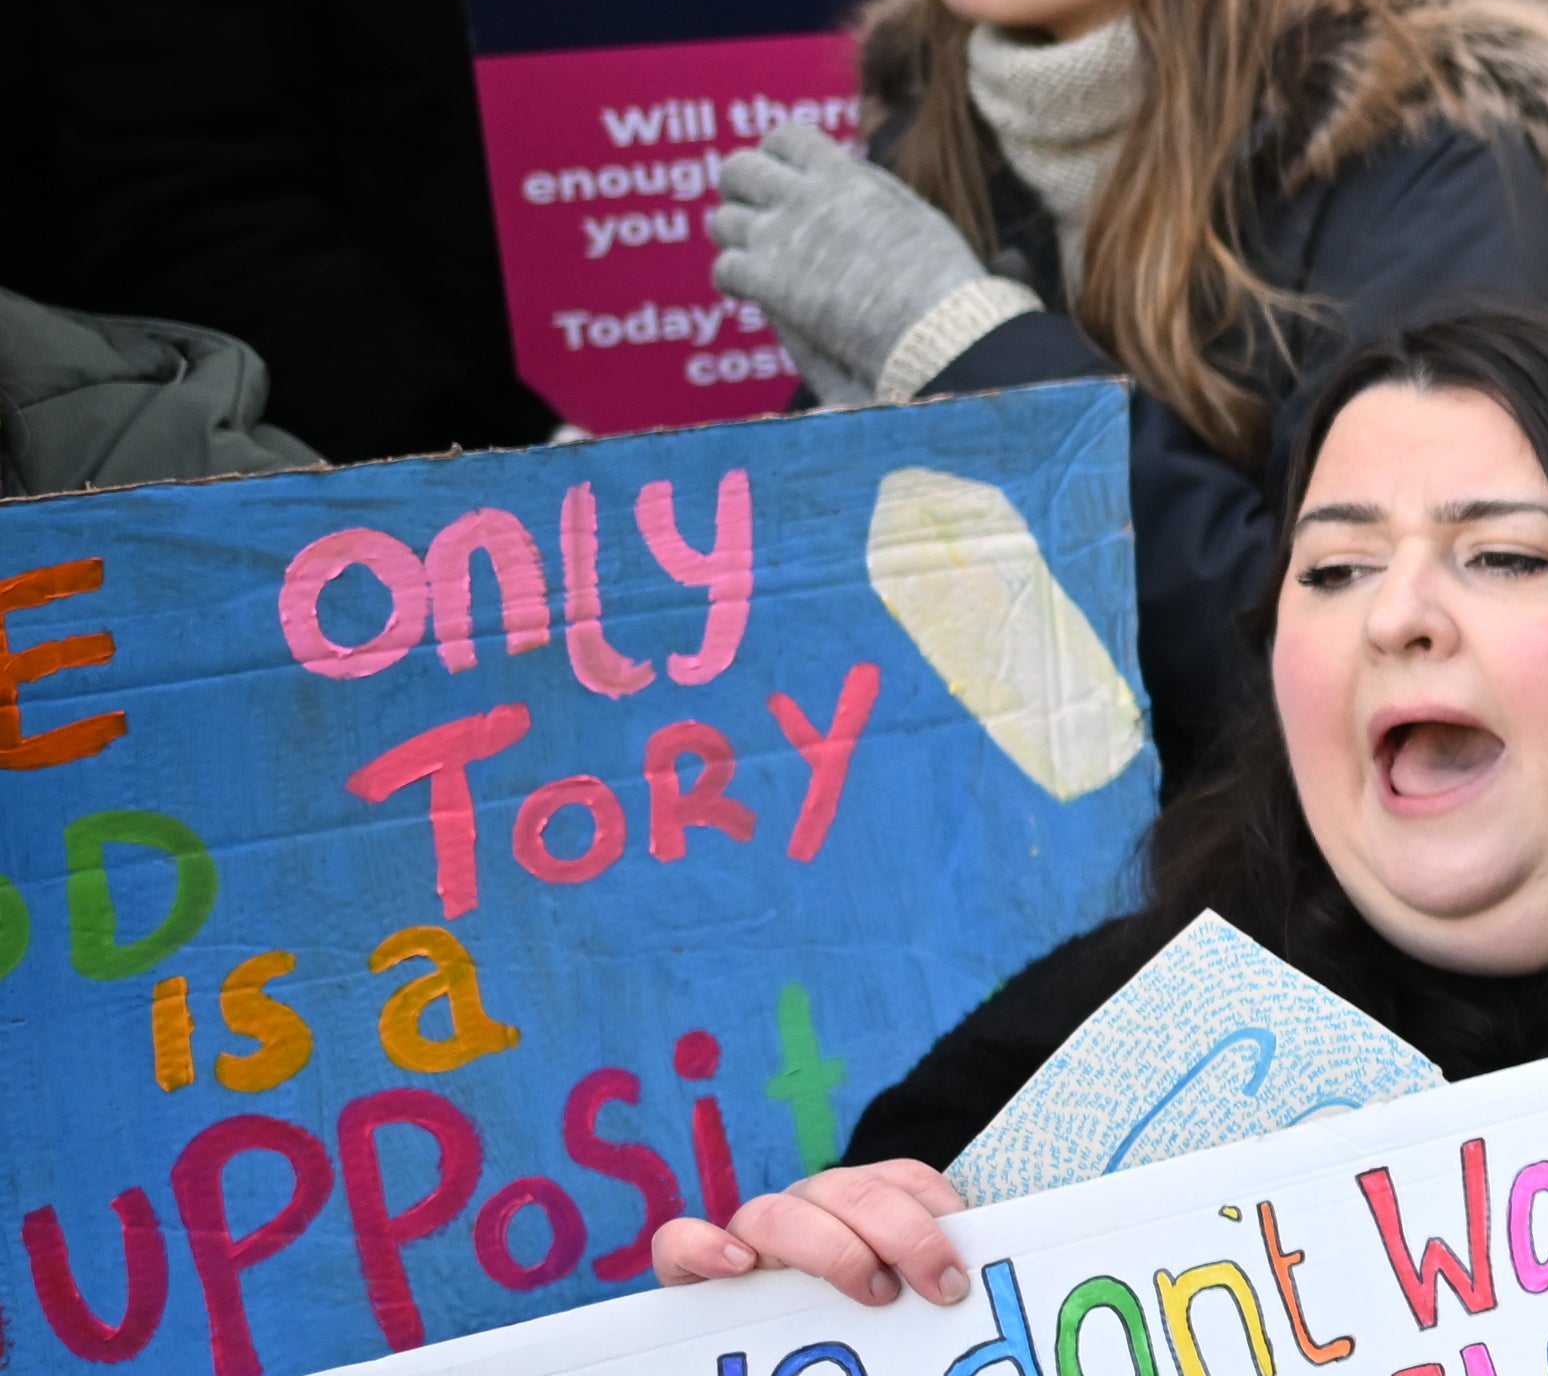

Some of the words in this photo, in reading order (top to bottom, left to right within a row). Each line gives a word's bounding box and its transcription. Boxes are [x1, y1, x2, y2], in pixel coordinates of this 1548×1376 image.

[601, 97, 718, 149] Will
[581, 208, 690, 259] you
[553, 294, 769, 352] Today's
[0, 808, 219, 983] D
[150, 949, 315, 1094] is
[368, 924, 522, 1074] a
